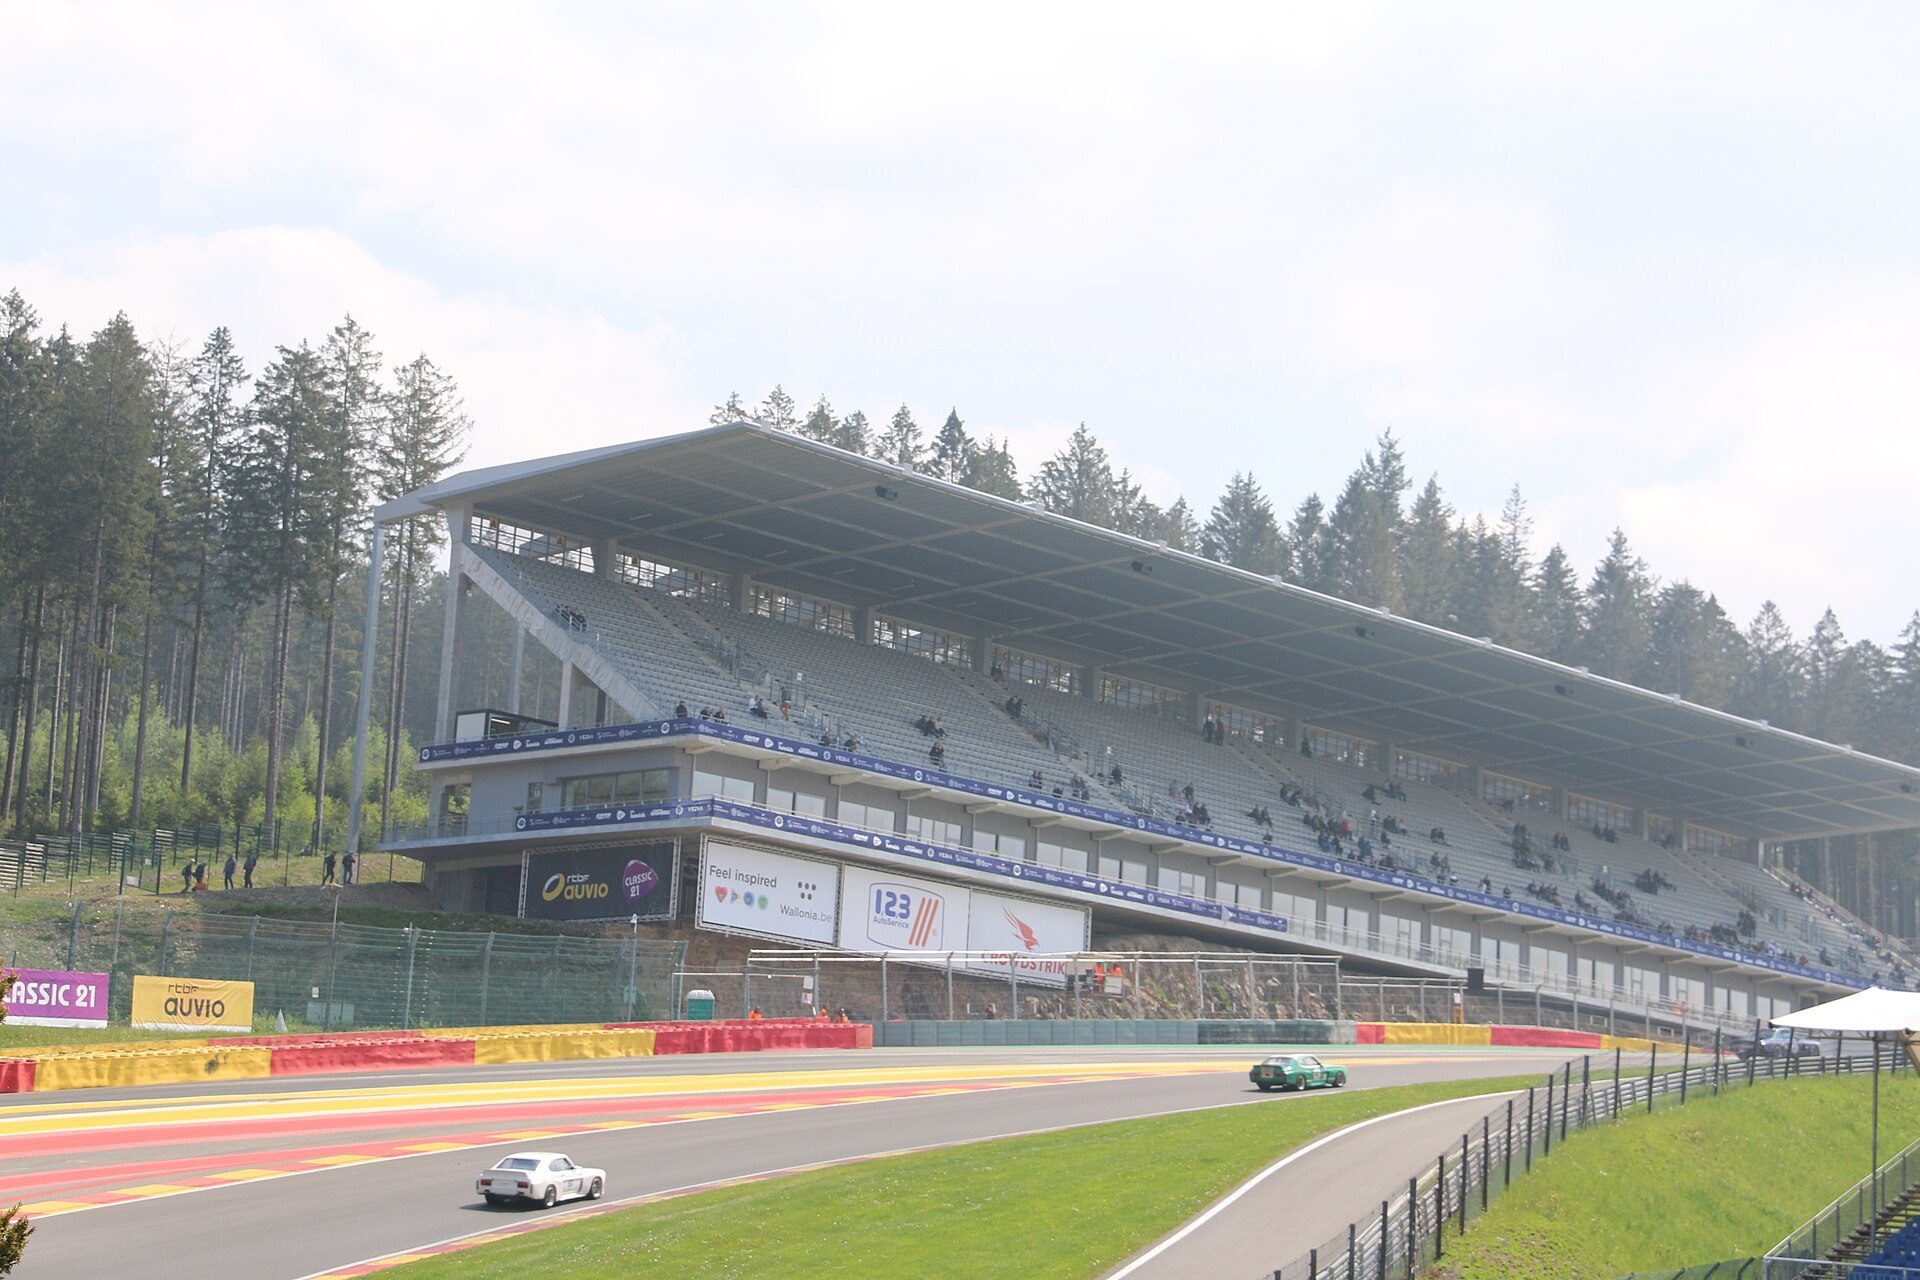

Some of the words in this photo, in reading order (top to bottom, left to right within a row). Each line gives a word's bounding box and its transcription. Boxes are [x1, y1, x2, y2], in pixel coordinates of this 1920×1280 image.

[625, 871, 652, 887] CLASSIC
[709, 865, 731, 880] Feel
[735, 869, 777, 888] inspired
[630, 885, 640, 897] 21
[780, 904, 832, 923] Wallonia.be
[873, 915, 909, 929] AutoService
[981, 952, 1067, 974] CROWDSTRIK
[75, 984, 96, 1007] 21
